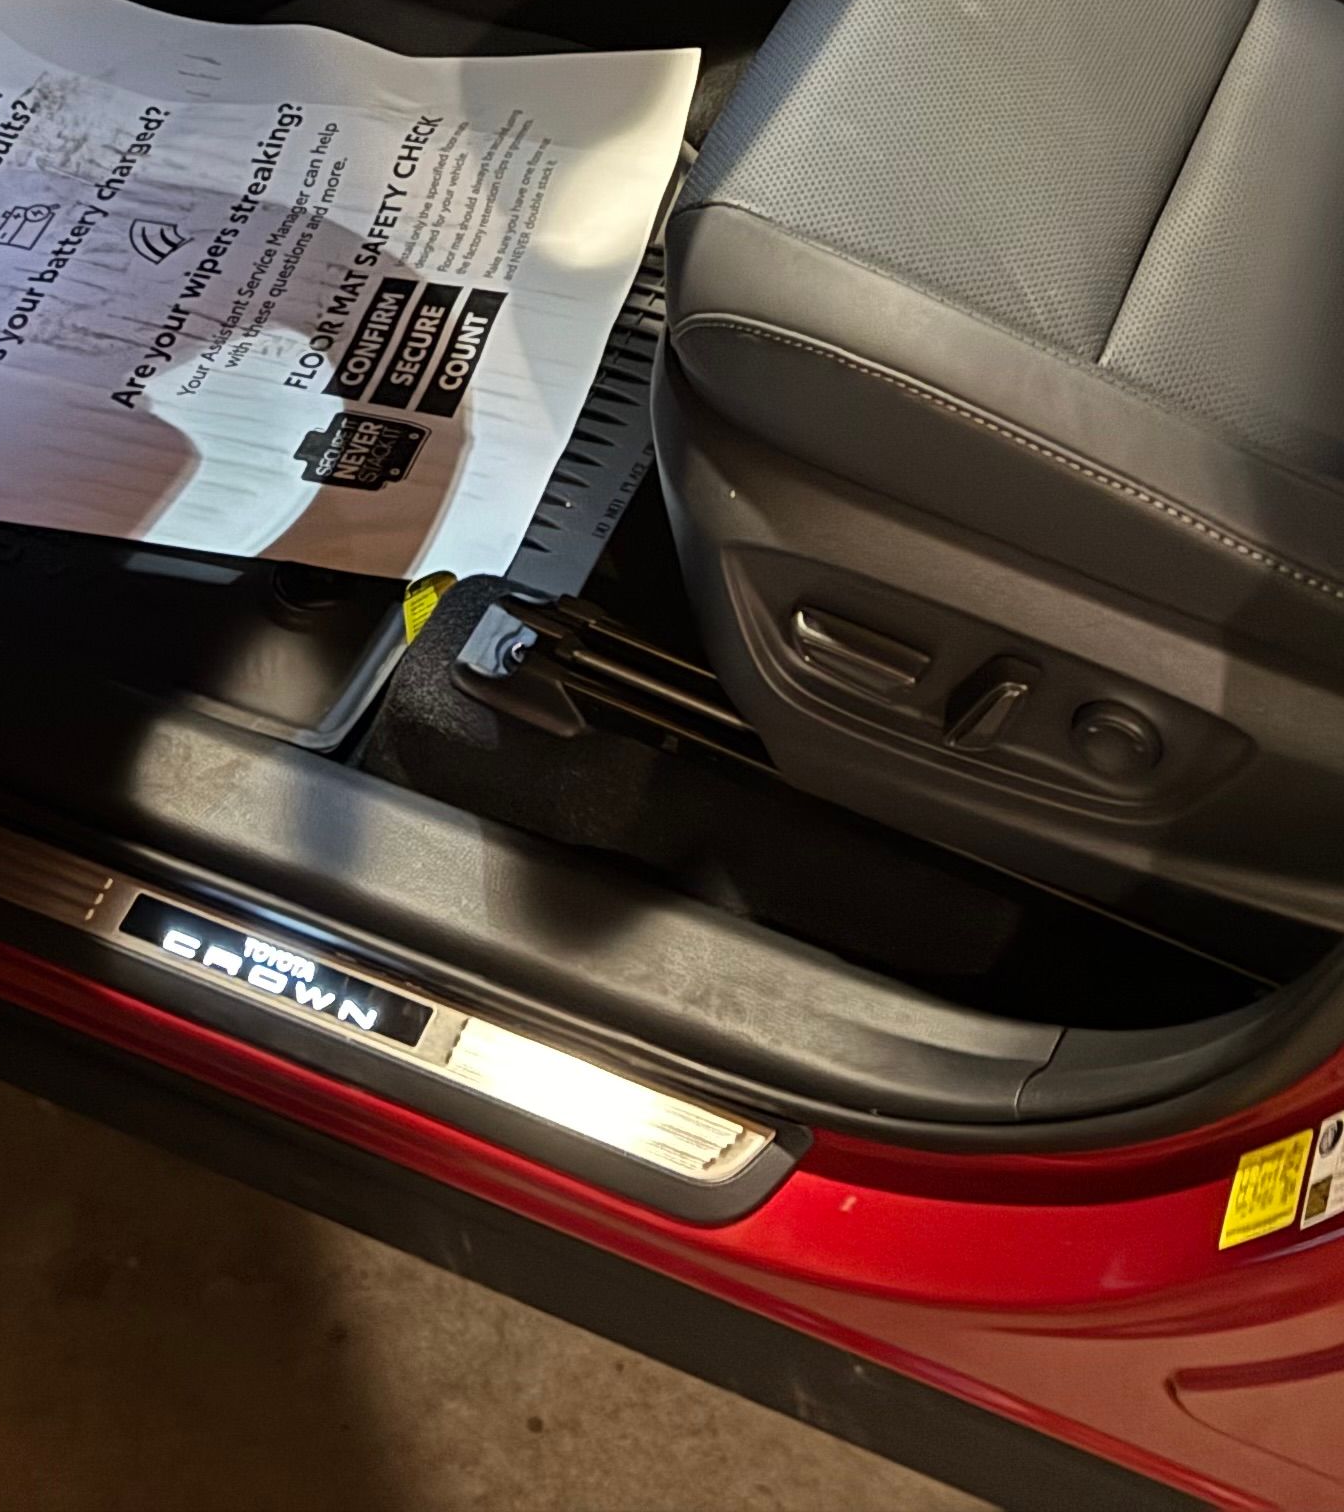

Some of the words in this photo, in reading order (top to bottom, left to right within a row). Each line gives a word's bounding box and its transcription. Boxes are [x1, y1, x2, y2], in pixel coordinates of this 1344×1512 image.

[310, 123, 339, 161] help
[304, 164, 320, 189] can
[419, 203, 433, 219] the
[426, 154, 449, 199] specified
[442, 189, 455, 213] your
[1, 288, 46, 345] your
[28, 204, 109, 284] battery
[94, 106, 171, 201] charged?
[265, 190, 311, 248] Manager
[458, 197, 478, 232] should
[464, 228, 487, 261] factory
[481, 181, 500, 228] retention
[510, 232, 532, 263] NEVER
[525, 193, 545, 229] double
[111, 363, 156, 409] Are
[145, 303, 190, 362] your
[180, 227, 240, 302] wipers
[230, 103, 303, 225] streaking?
[225, 339, 253, 369] with
[245, 299, 276, 338] these
[273, 231, 313, 298] questions
[307, 206, 329, 231] and
[323, 157, 348, 205] more.
[238, 249, 274, 300] Service
[284, 320, 343, 390] FLOOR
[328, 271, 370, 326] MAT
[355, 184, 408, 268] SAFETY
[393, 116, 444, 179] CHECK
[204, 298, 250, 362] Assistant
[340, 292, 406, 386] CONFIRM
[391, 304, 446, 387] SECURE
[439, 312, 488, 391] COUNT
[176, 363, 210, 397] Your
[334, 421, 384, 480] NEVER
[358, 439, 397, 483] STACK
[382, 426, 400, 439] IT
[162, 928, 378, 1031] CROWN
[243, 936, 316, 983] TOYOTA
